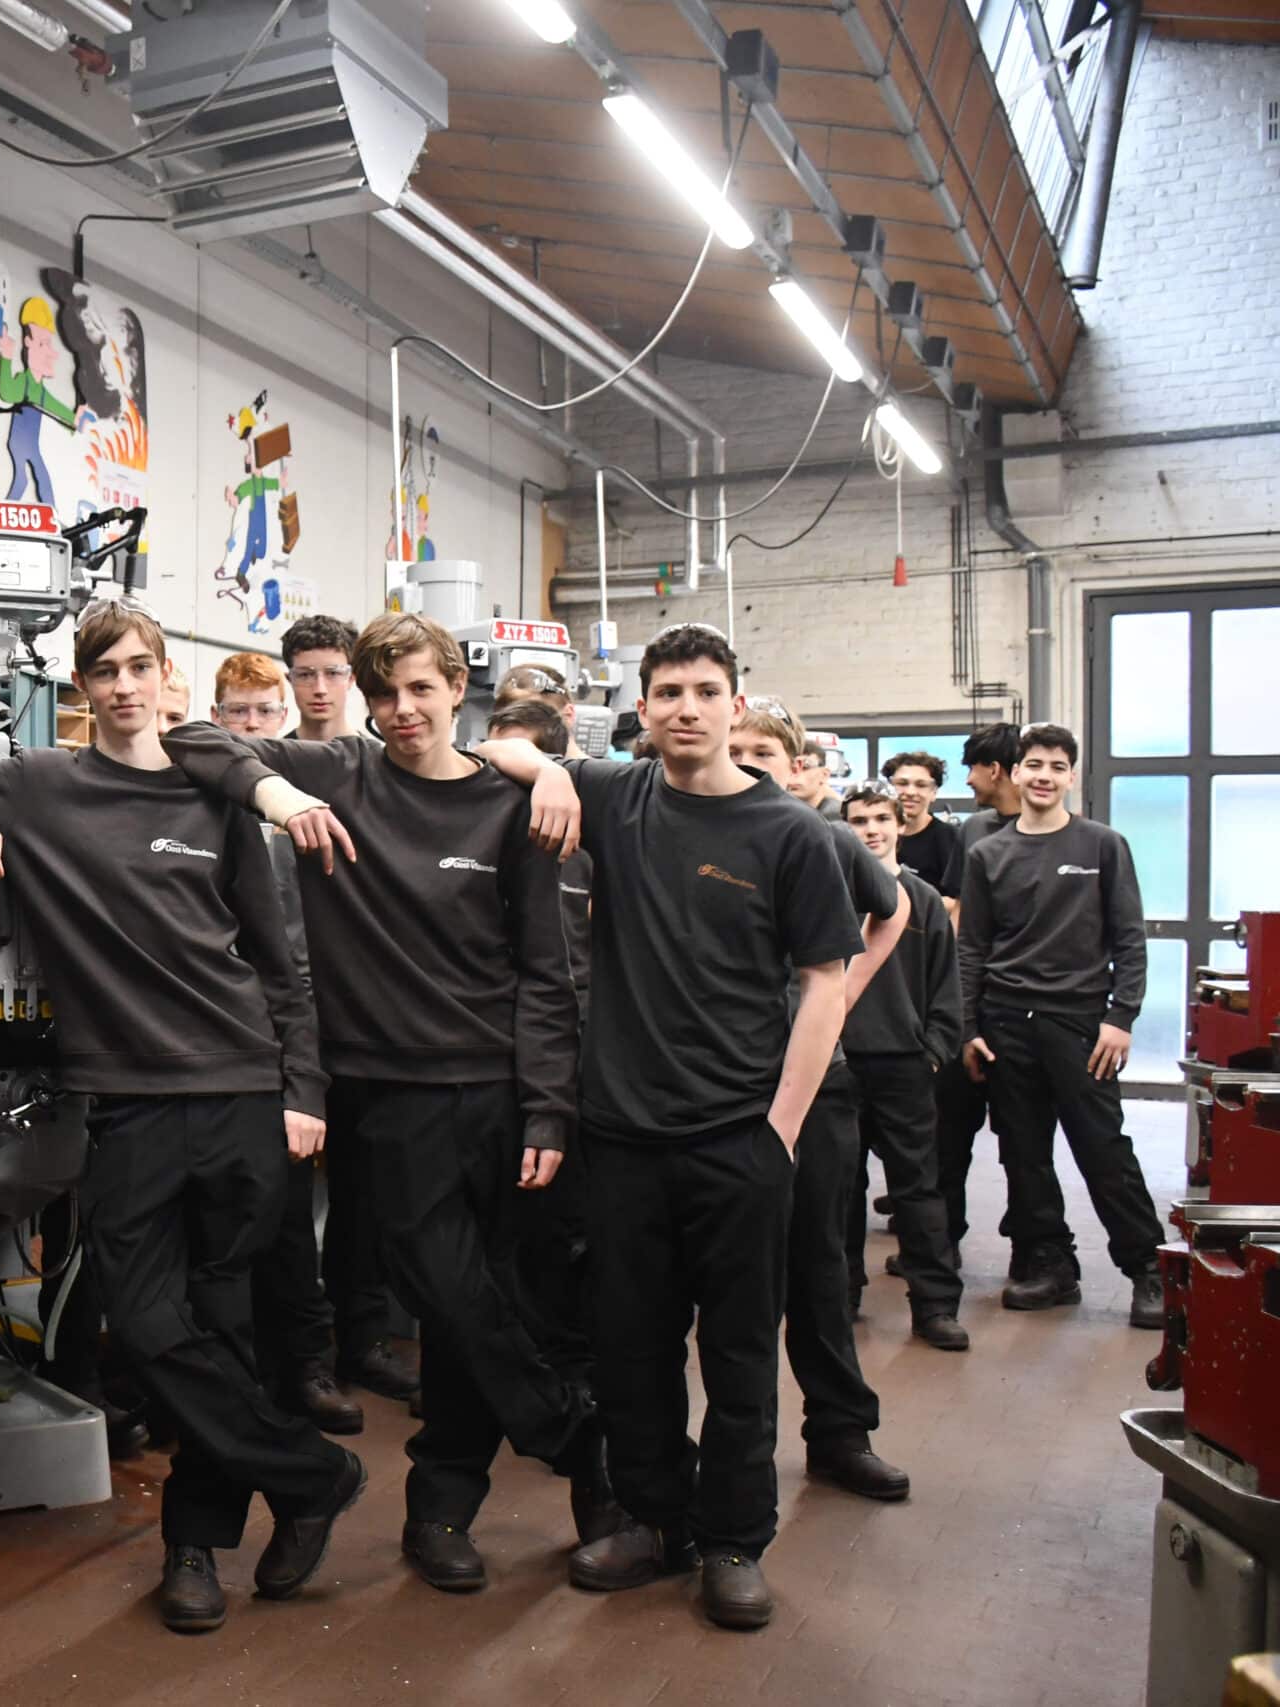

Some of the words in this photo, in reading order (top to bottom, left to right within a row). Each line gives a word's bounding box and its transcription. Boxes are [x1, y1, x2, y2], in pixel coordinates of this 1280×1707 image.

[0, 506, 42, 529] 1500
[503, 623, 528, 640] XYZ
[532, 626, 559, 643] 1500
